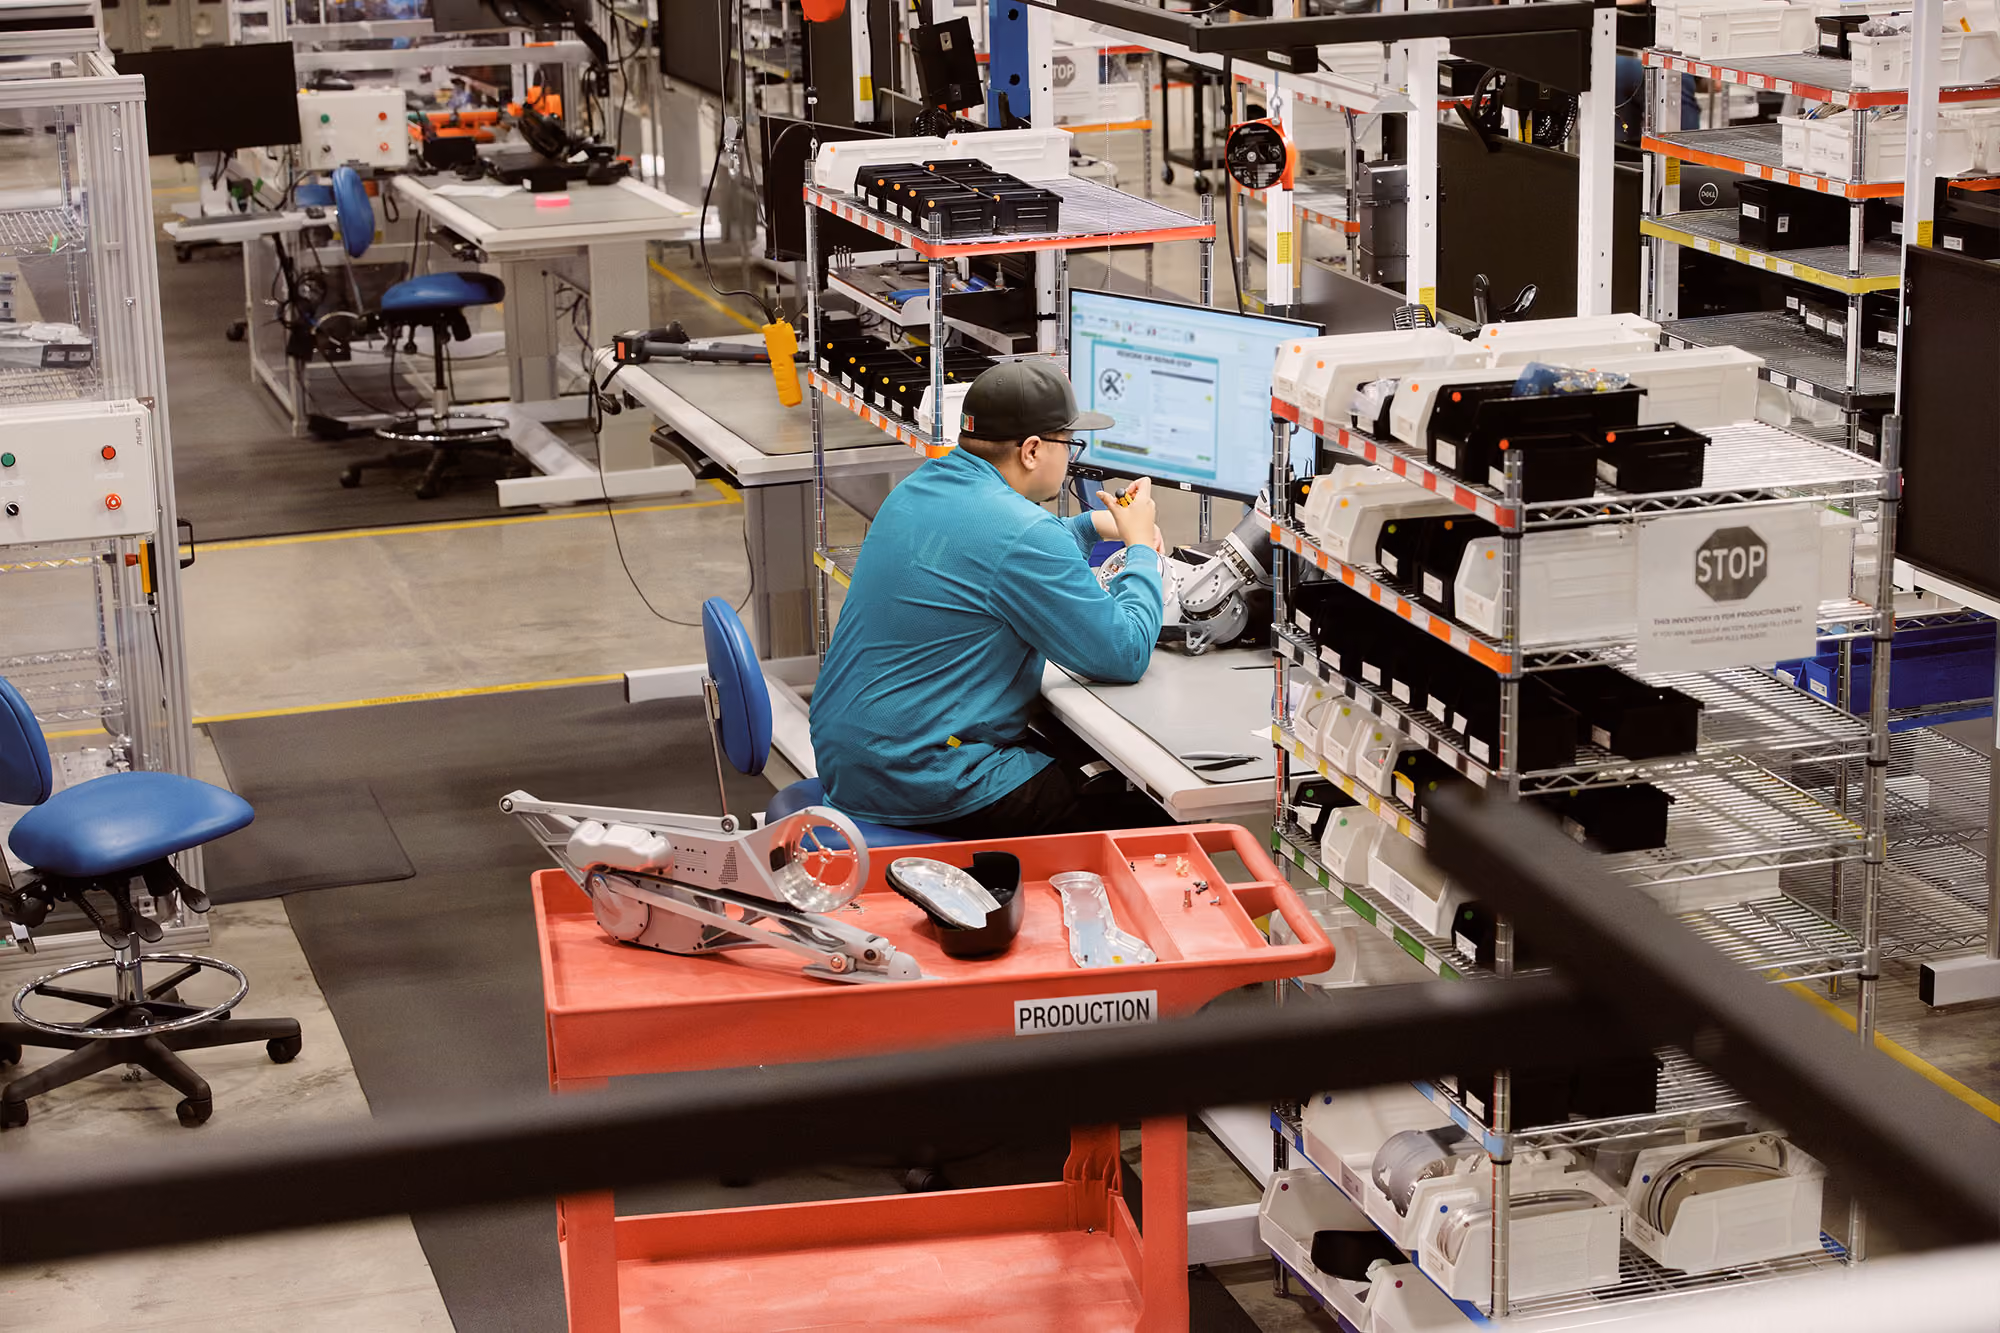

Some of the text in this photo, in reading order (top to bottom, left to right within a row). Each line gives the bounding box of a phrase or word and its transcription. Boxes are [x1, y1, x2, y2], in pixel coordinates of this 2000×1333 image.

[1052, 64, 1074, 80] TOP
[1697, 545, 1766, 583] STOP
[1654, 617, 1671, 625] THIS
[1672, 615, 1712, 624] INVENTORY
[1722, 612, 1735, 620] FOR
[1736, 608, 1782, 618] PRODUCTION
[1020, 998, 1150, 1029] PRODUCTION
